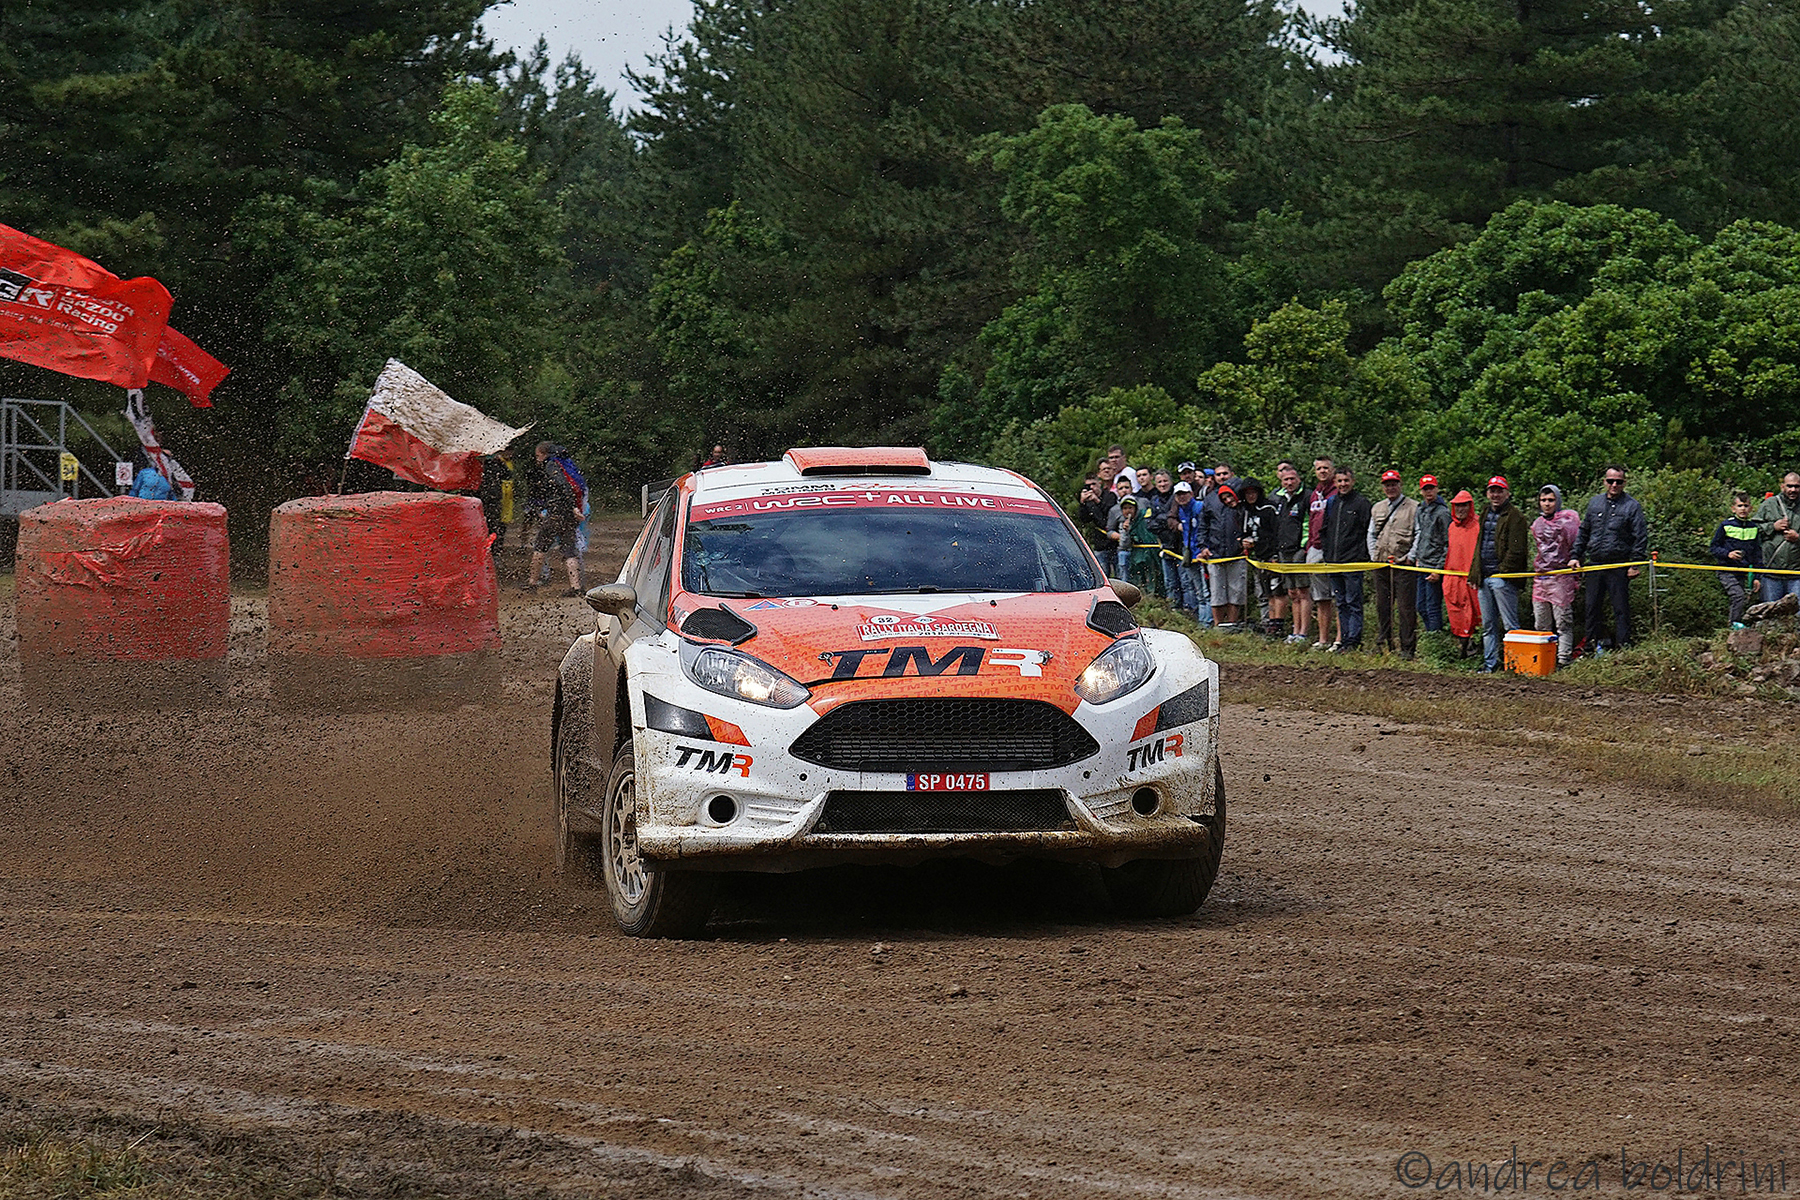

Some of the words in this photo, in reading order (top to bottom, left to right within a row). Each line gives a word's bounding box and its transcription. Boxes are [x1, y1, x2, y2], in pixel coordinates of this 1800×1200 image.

[57, 301, 118, 335] Racing
[704, 506, 734, 515] WRC
[735, 504, 743, 512] 2
[887, 494, 934, 505] ALL
[941, 496, 996, 508] LIVE
[862, 624, 895, 637] RALLY
[898, 623, 933, 633] ITALIA
[933, 622, 995, 634] SARDEGNA
[831, 646, 1048, 679] TMR
[675, 744, 754, 778] TMR
[1126, 734, 1184, 772] TMR
[919, 773, 941, 790] SP
[945, 773, 985, 790] 0475
